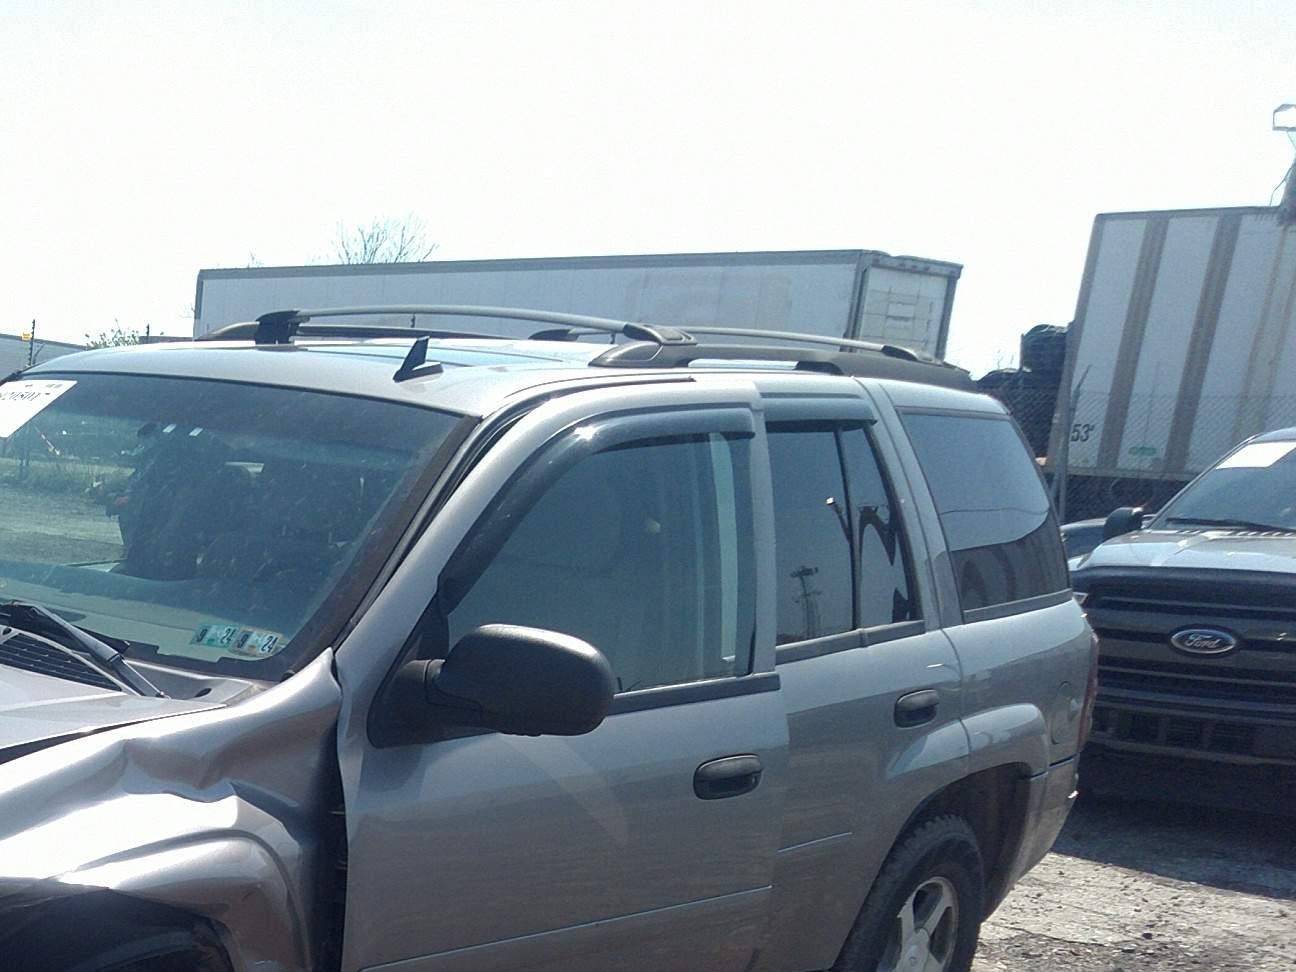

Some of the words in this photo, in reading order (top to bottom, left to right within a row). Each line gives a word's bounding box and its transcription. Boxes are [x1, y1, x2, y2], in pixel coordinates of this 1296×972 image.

[220, 627, 237, 645] 24
[260, 635, 279, 653] 24
[1185, 632, 1222, 649] Ford
